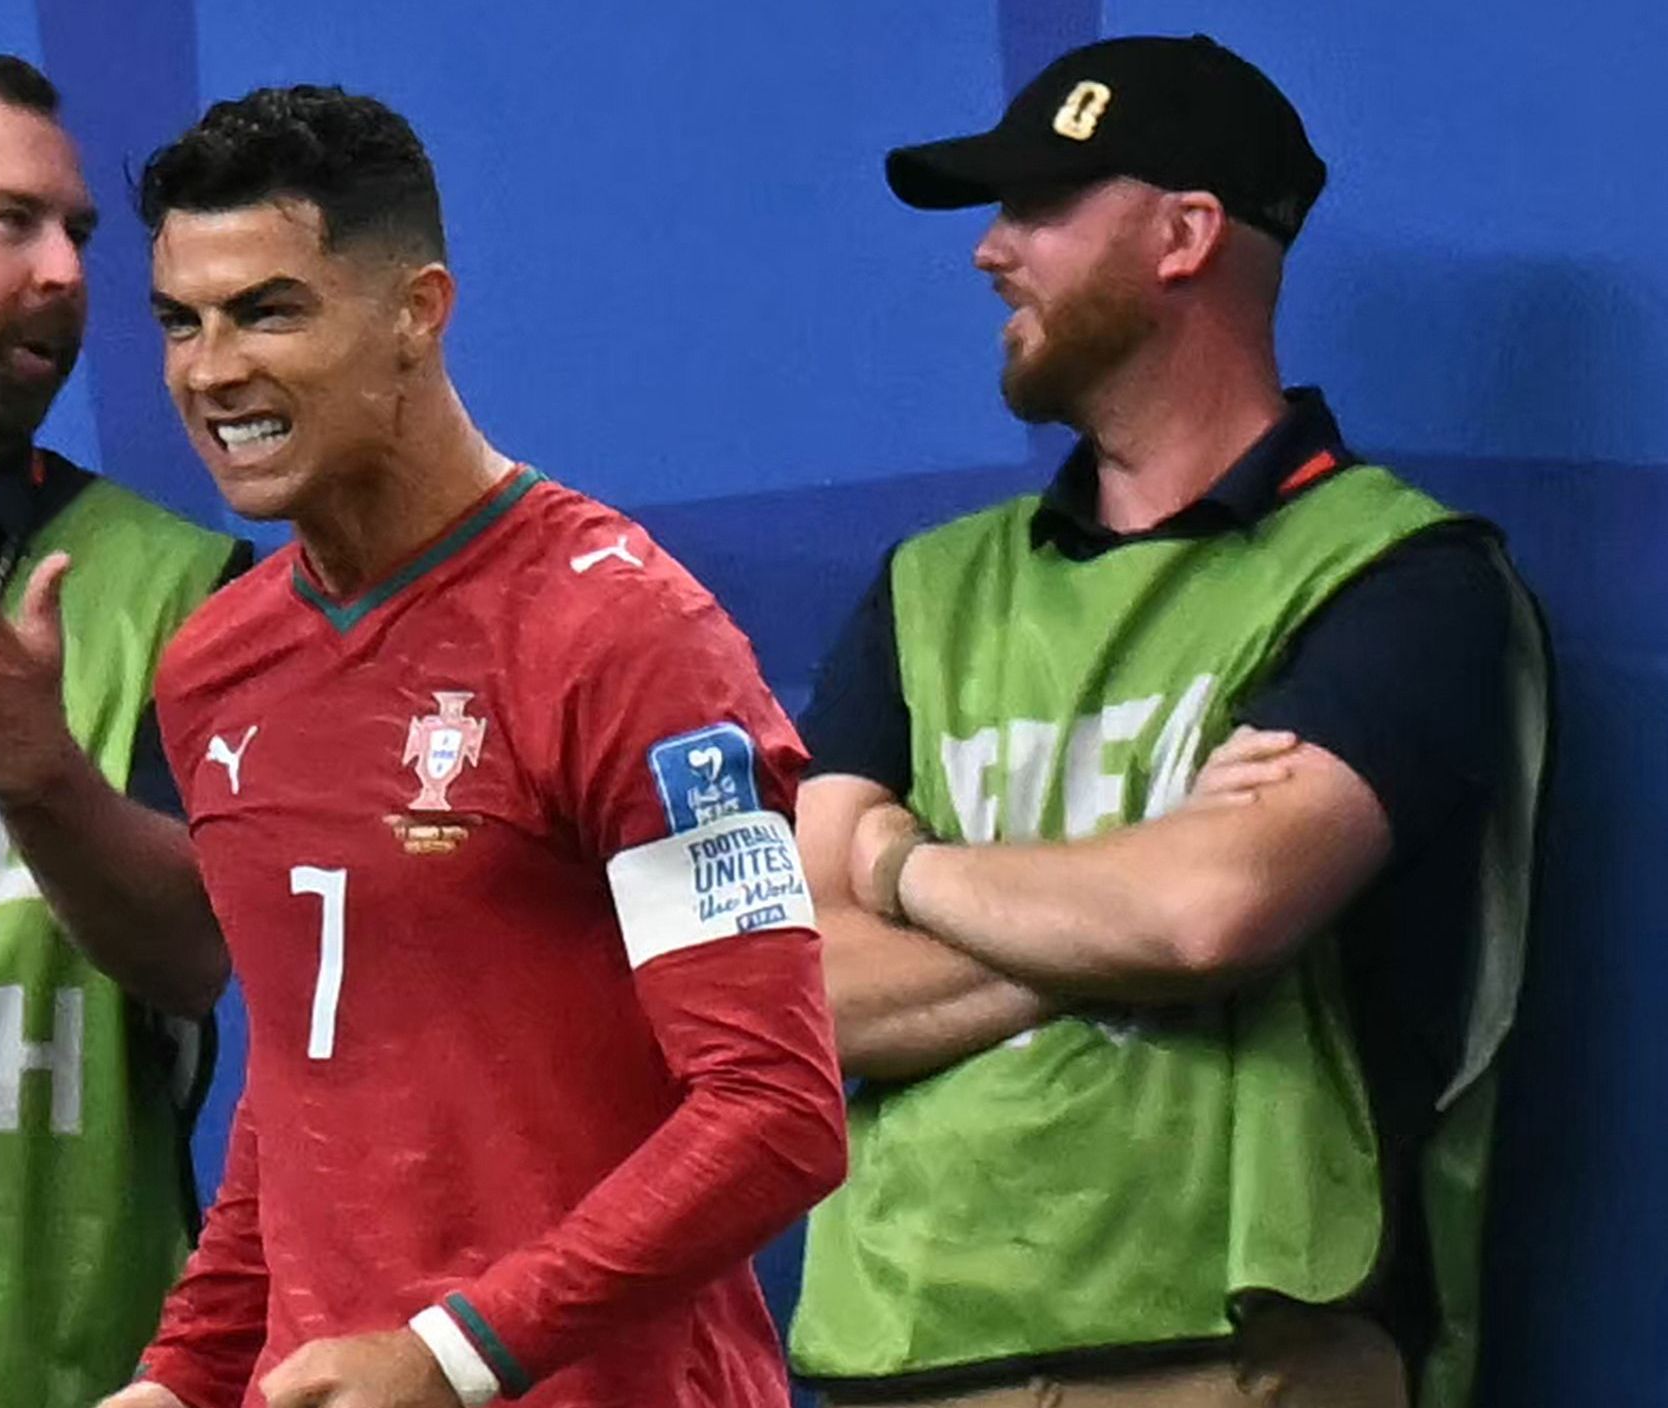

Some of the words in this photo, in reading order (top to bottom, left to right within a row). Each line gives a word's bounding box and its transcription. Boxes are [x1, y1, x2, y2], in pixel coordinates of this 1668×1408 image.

[689, 823, 783, 866] FOOTBALL
[694, 845, 793, 893] UNITES
[741, 876, 804, 906] World
[290, 865, 347, 1059] 7
